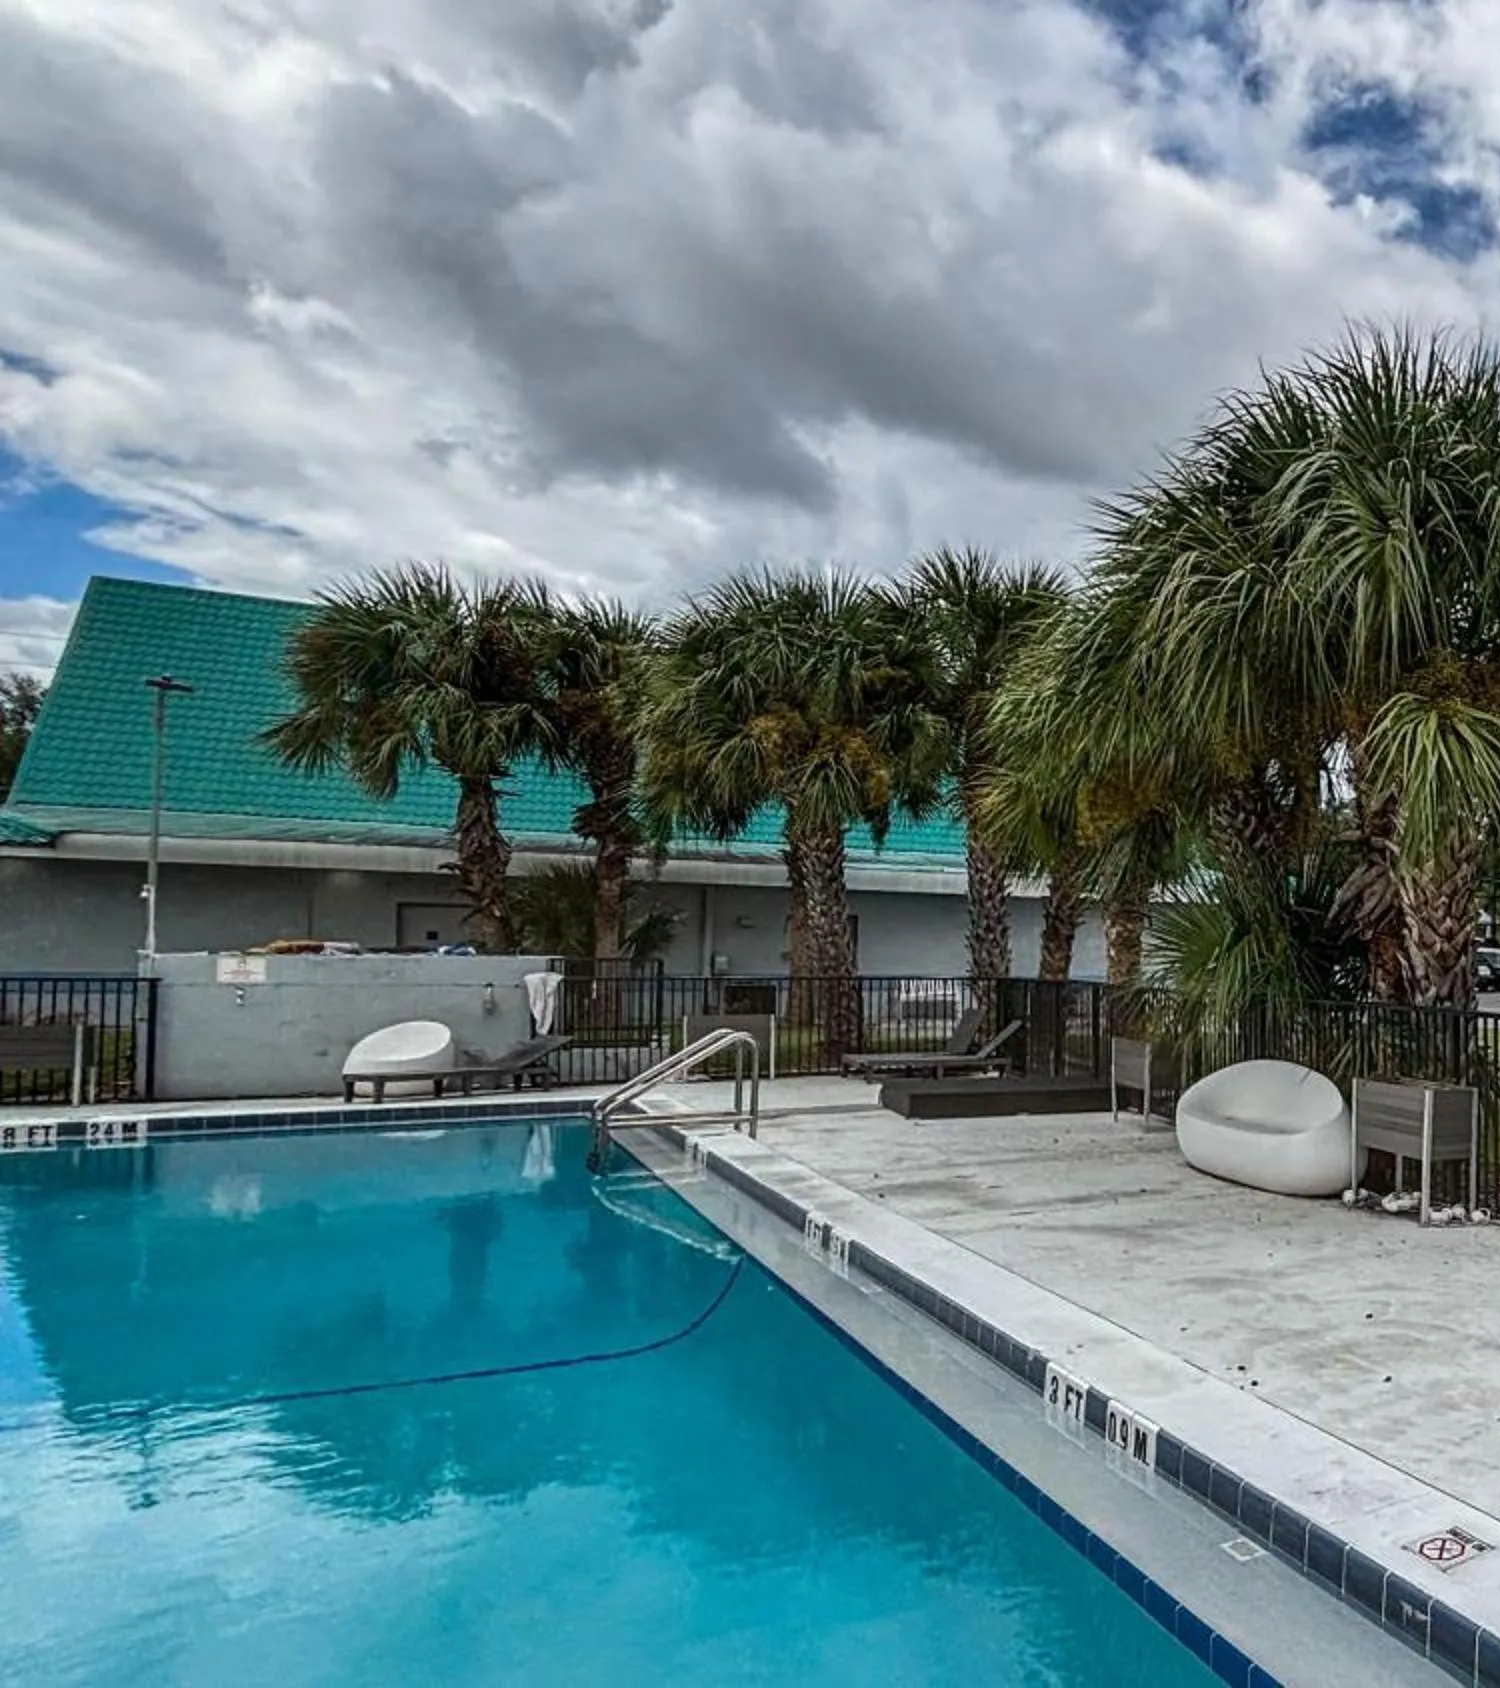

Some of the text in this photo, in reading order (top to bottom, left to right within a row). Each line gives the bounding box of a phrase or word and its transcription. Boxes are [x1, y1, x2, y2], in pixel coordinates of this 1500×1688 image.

[28, 1125, 53, 1141] FT
[1049, 1375, 1083, 1420] 3 FT
[1133, 1427, 1149, 1466] M
